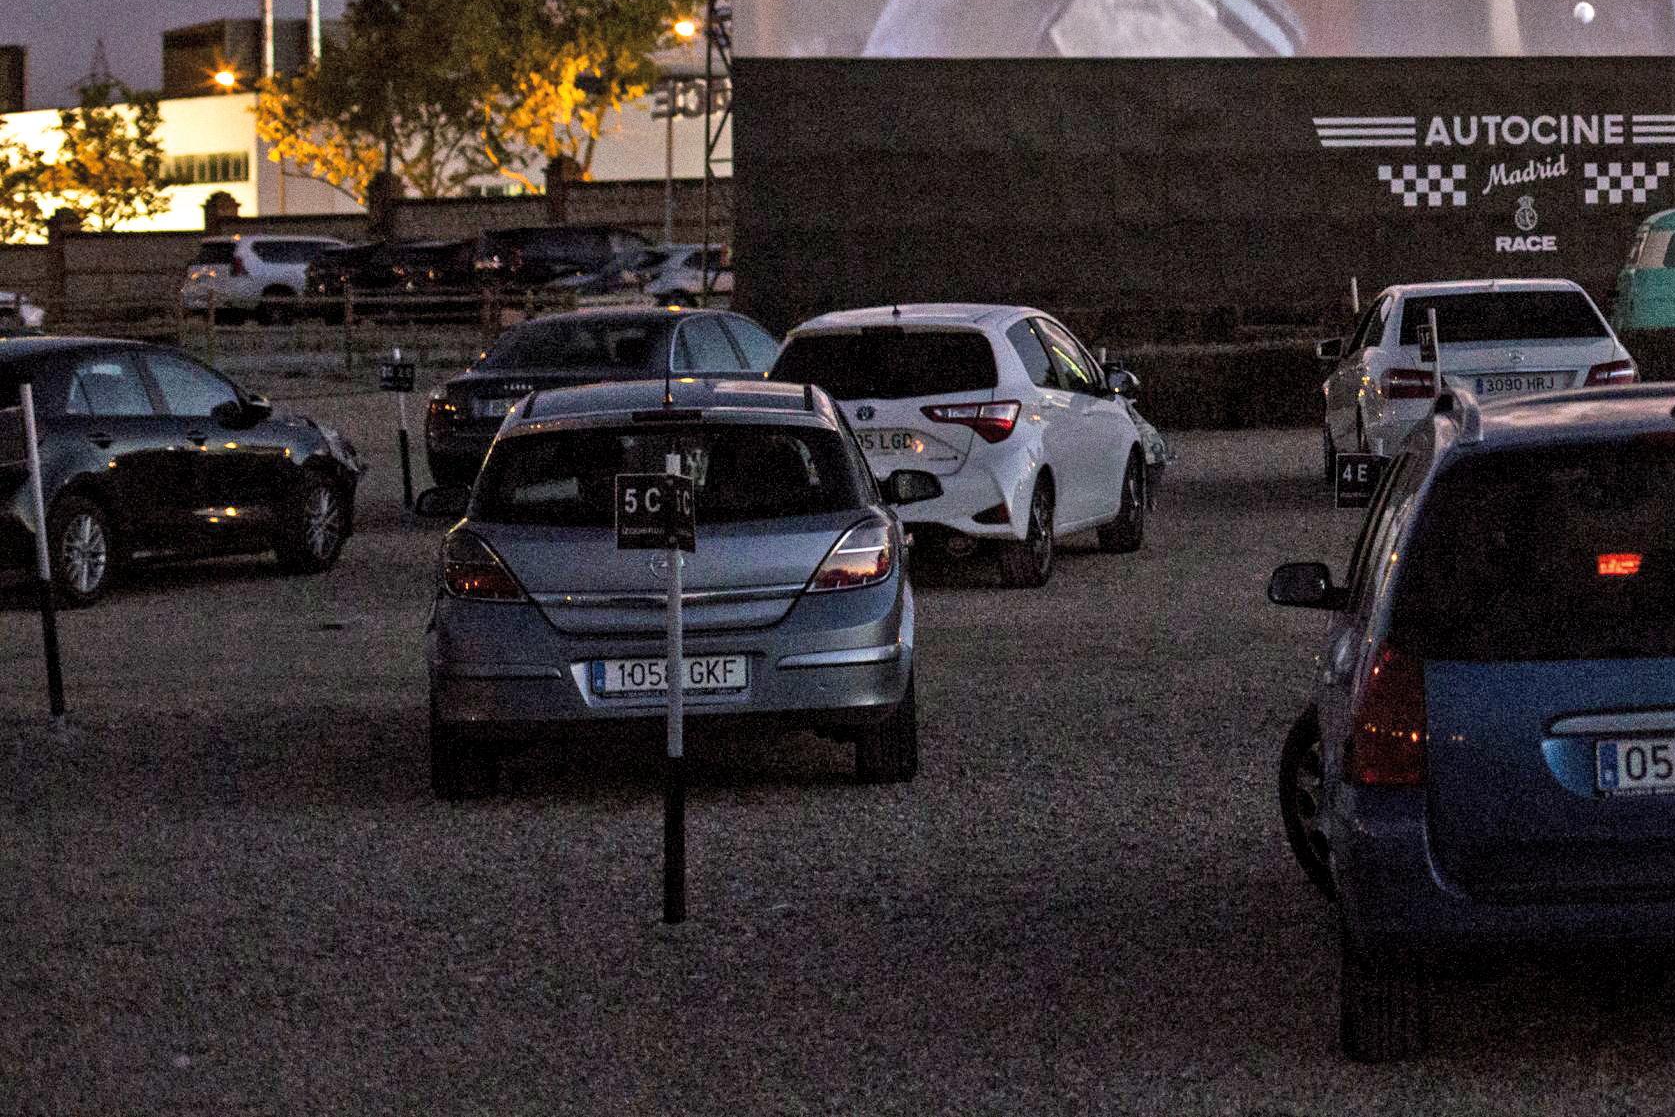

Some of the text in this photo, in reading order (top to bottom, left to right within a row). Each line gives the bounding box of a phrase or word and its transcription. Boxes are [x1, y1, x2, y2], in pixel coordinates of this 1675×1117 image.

[1425, 114, 1624, 147] AUTOCINE
[1482, 154, 1569, 195] Madrid
[1496, 236, 1557, 252] RACE
[1486, 377, 1554, 392] 3090 HRJ
[689, 660, 736, 685] GKF
